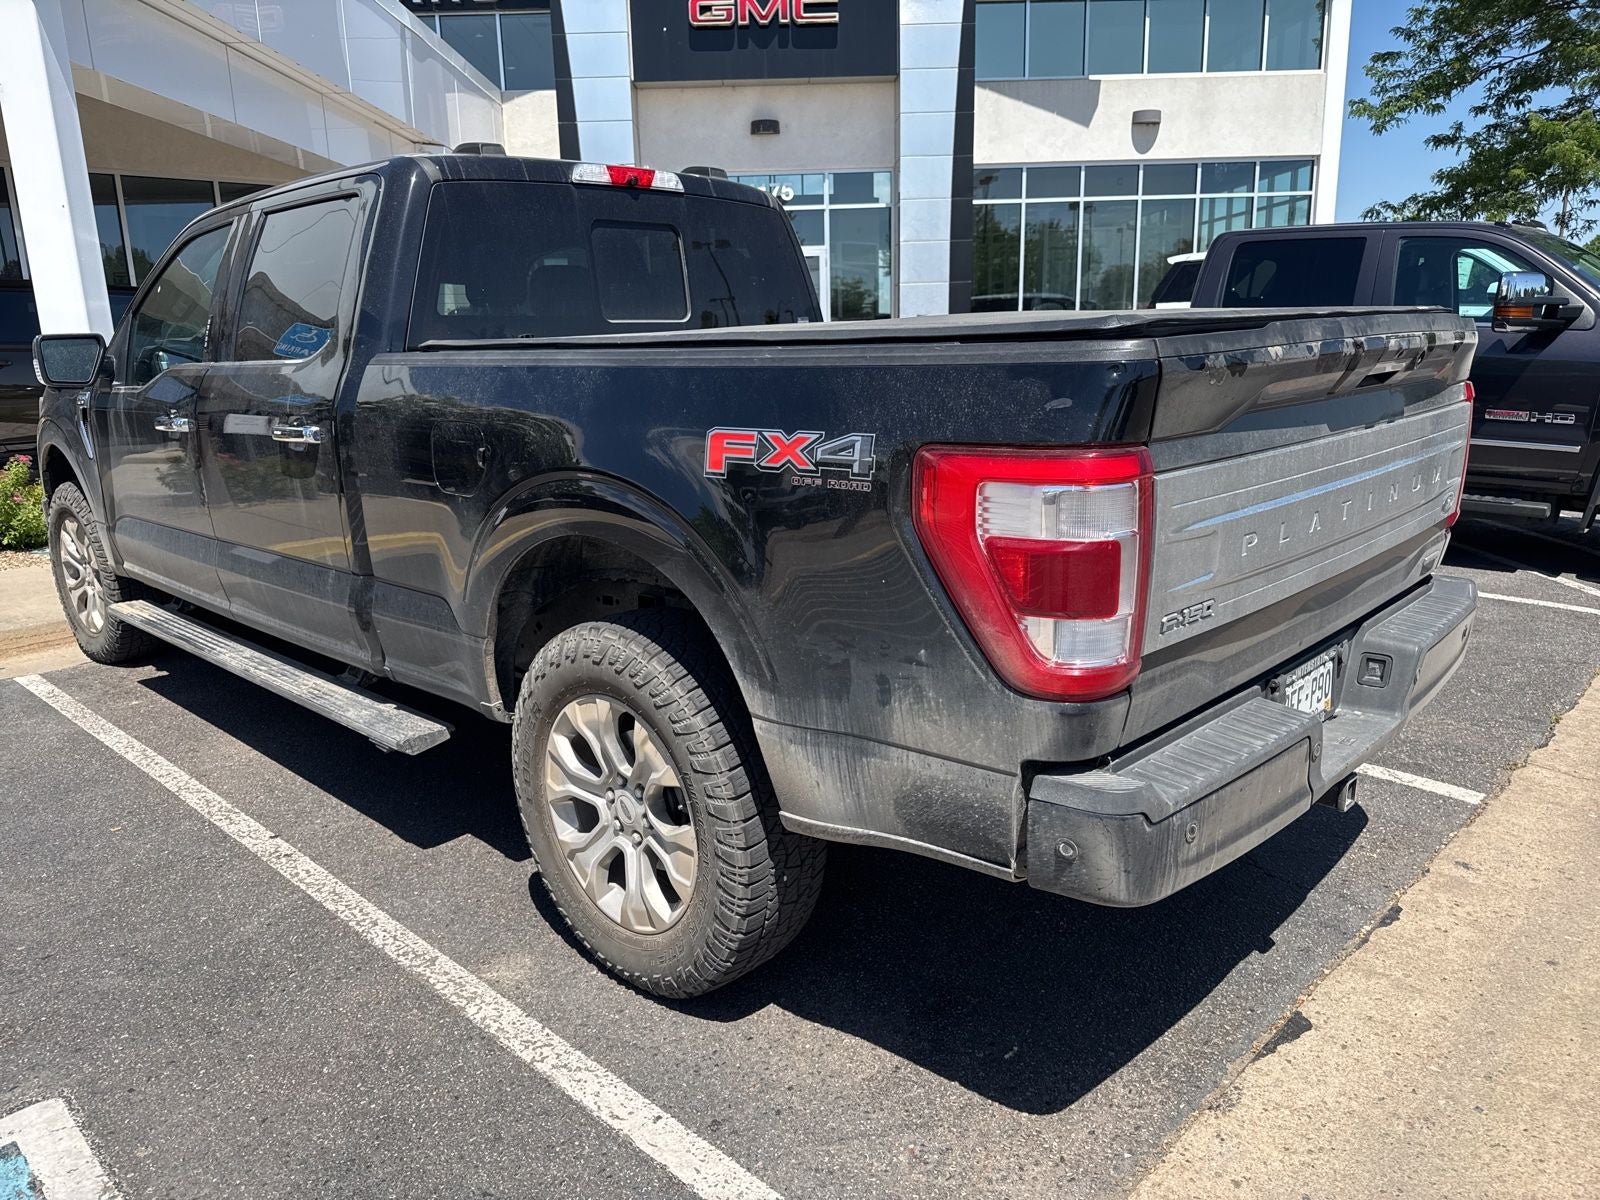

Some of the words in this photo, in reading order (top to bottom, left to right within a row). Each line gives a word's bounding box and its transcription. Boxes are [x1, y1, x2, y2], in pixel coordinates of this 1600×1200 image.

[688, 0, 840, 26] GMC
[703, 426, 876, 480] FX4
[791, 475, 823, 487] OFF
[827, 478, 872, 493] ROAD
[1240, 464, 1444, 558] PLATINUM
